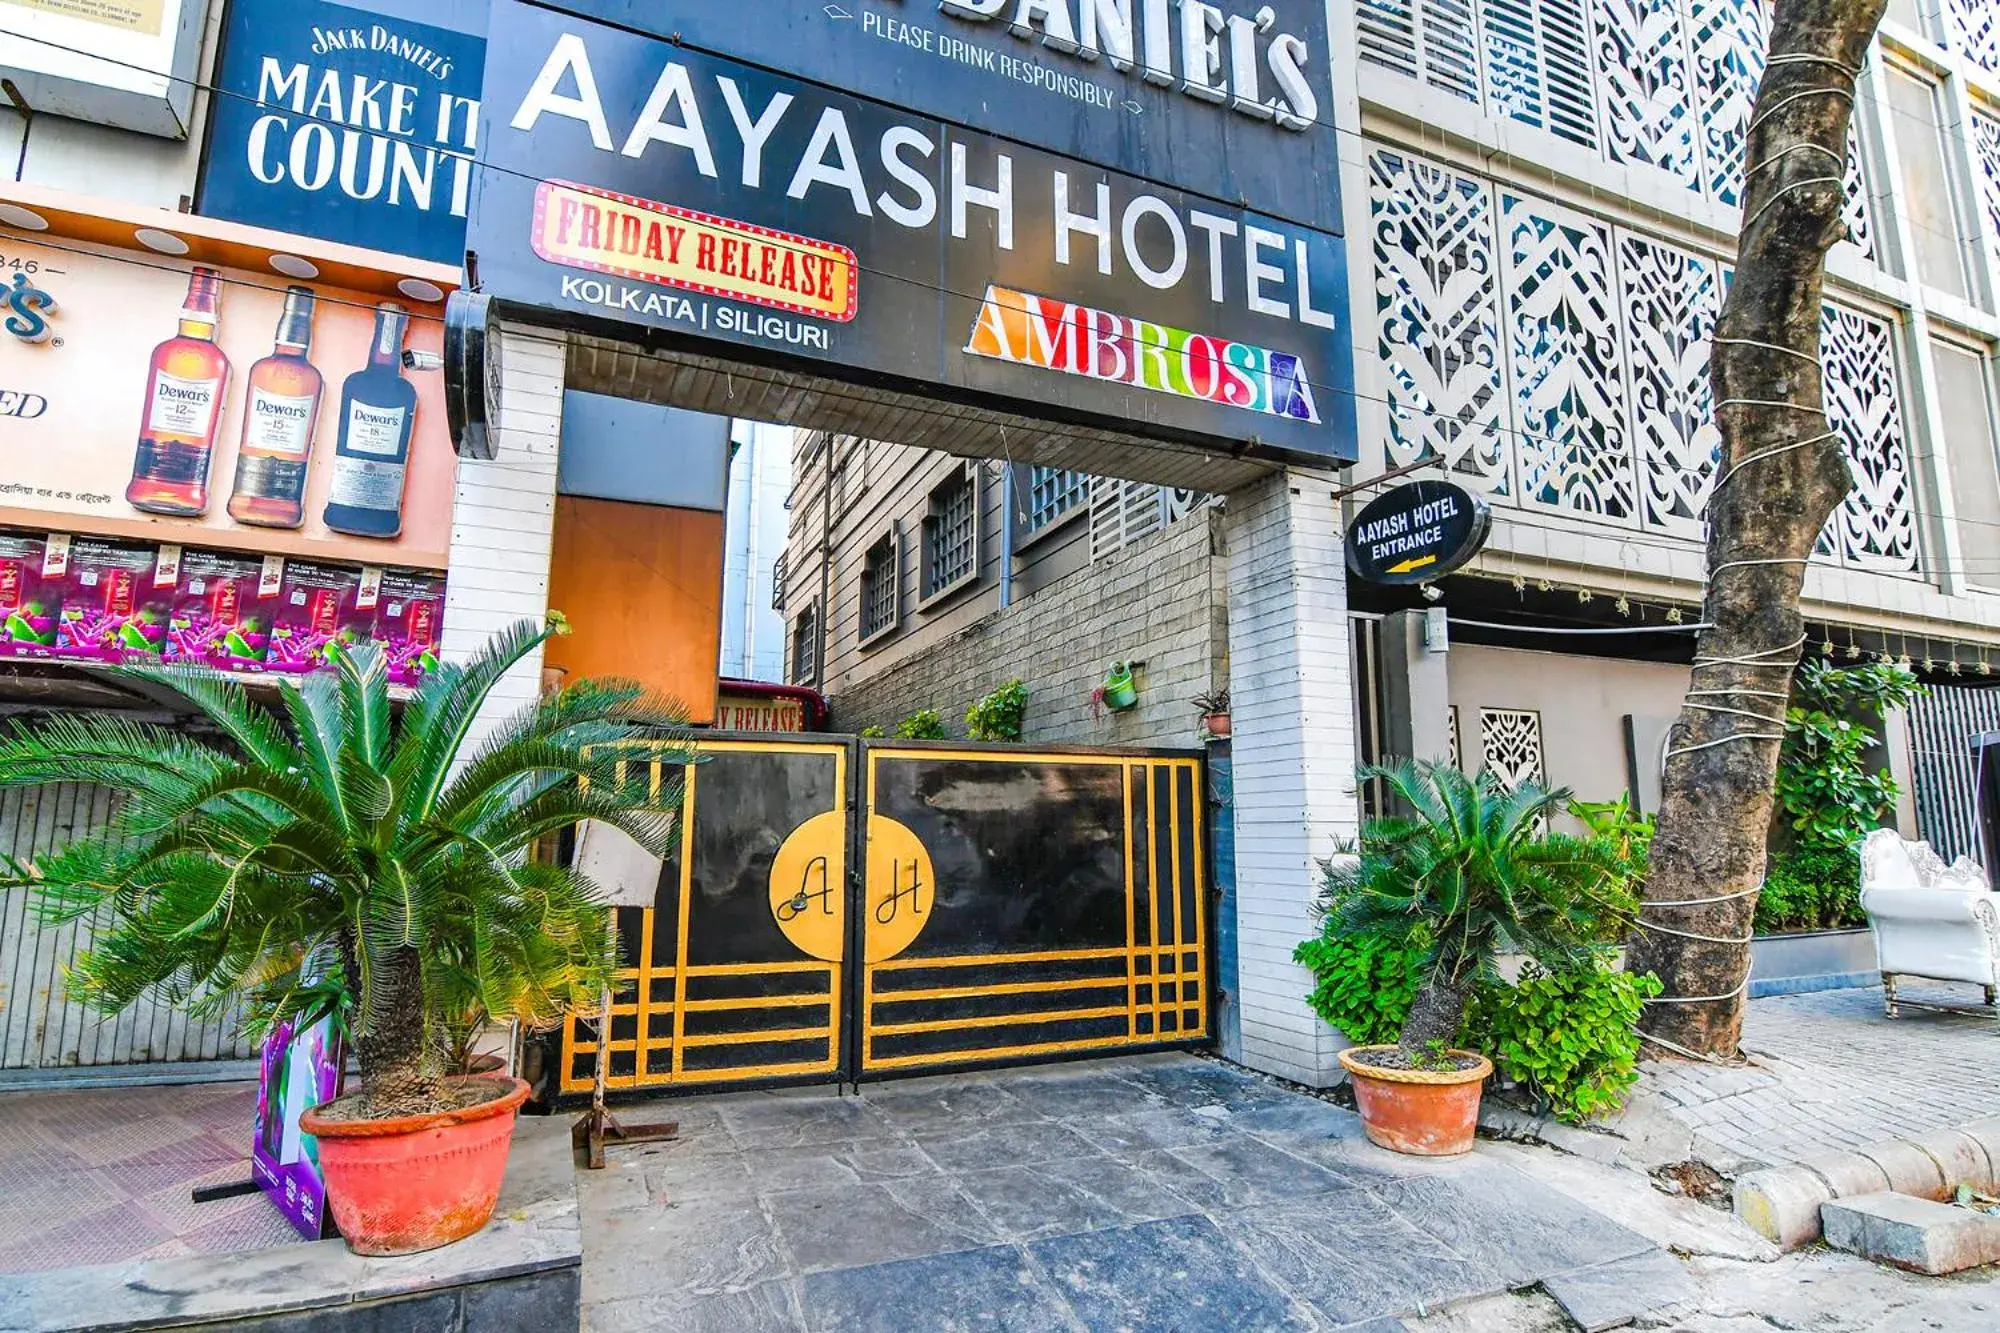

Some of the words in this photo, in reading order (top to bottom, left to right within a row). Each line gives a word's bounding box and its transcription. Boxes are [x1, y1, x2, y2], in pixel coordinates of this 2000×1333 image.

[312, 26, 367, 54] JACK
[371, 24, 455, 80] DANIEL'S
[863, 11, 933, 52] PLEASE
[939, 35, 996, 72] DRINK
[1000, 55, 1114, 109] RESPONSIBLY
[937, 0, 1319, 131] ANIEL'S
[255, 56, 418, 137] MAKE
[435, 92, 481, 150] IT
[510, 32, 1014, 251] AAYASH
[1054, 171, 1336, 330] HOTEL
[556, 196, 686, 264] FRIDAY
[696, 231, 835, 301] RELEASE
[561, 275, 696, 322] KOLKATA
[715, 306, 829, 350] SILIGURI
[965, 285, 1321, 425] AMBROSIA
[159, 383, 211, 403] Dewar's
[175, 404, 188, 415] 12
[256, 399, 307, 418] Dewar's
[354, 409, 399, 426] Dewar's
[272, 419, 284, 430] 15
[1357, 511, 1409, 547] AAYASH
[1413, 496, 1459, 529] HOTEL
[1372, 525, 1443, 561] ENTRANCE
[735, 706, 797, 733] RELEASE
[777, 856, 834, 921] A
